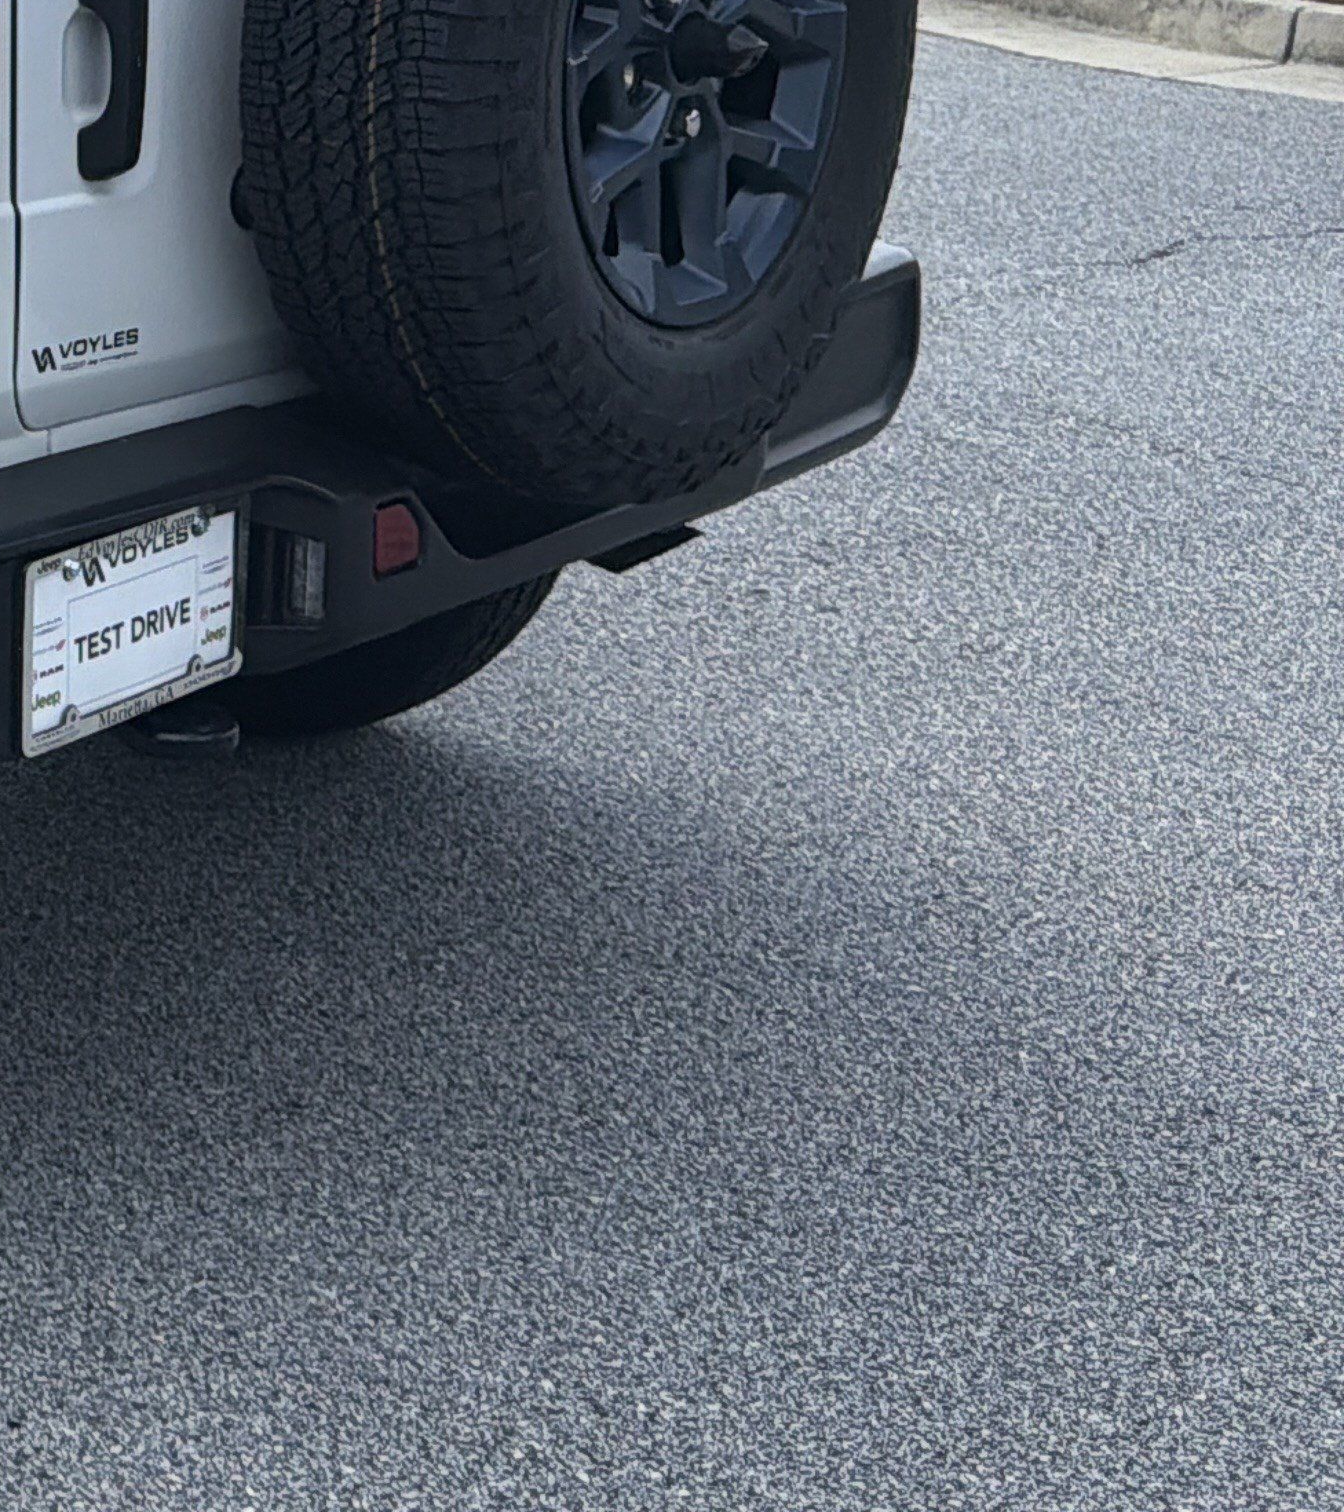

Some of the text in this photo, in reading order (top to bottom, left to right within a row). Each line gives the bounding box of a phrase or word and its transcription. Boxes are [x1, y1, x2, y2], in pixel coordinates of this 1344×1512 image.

[58, 327, 140, 359] VOYLES
[107, 525, 189, 569] VOYLES
[74, 597, 191, 664] TEST DRIVE
